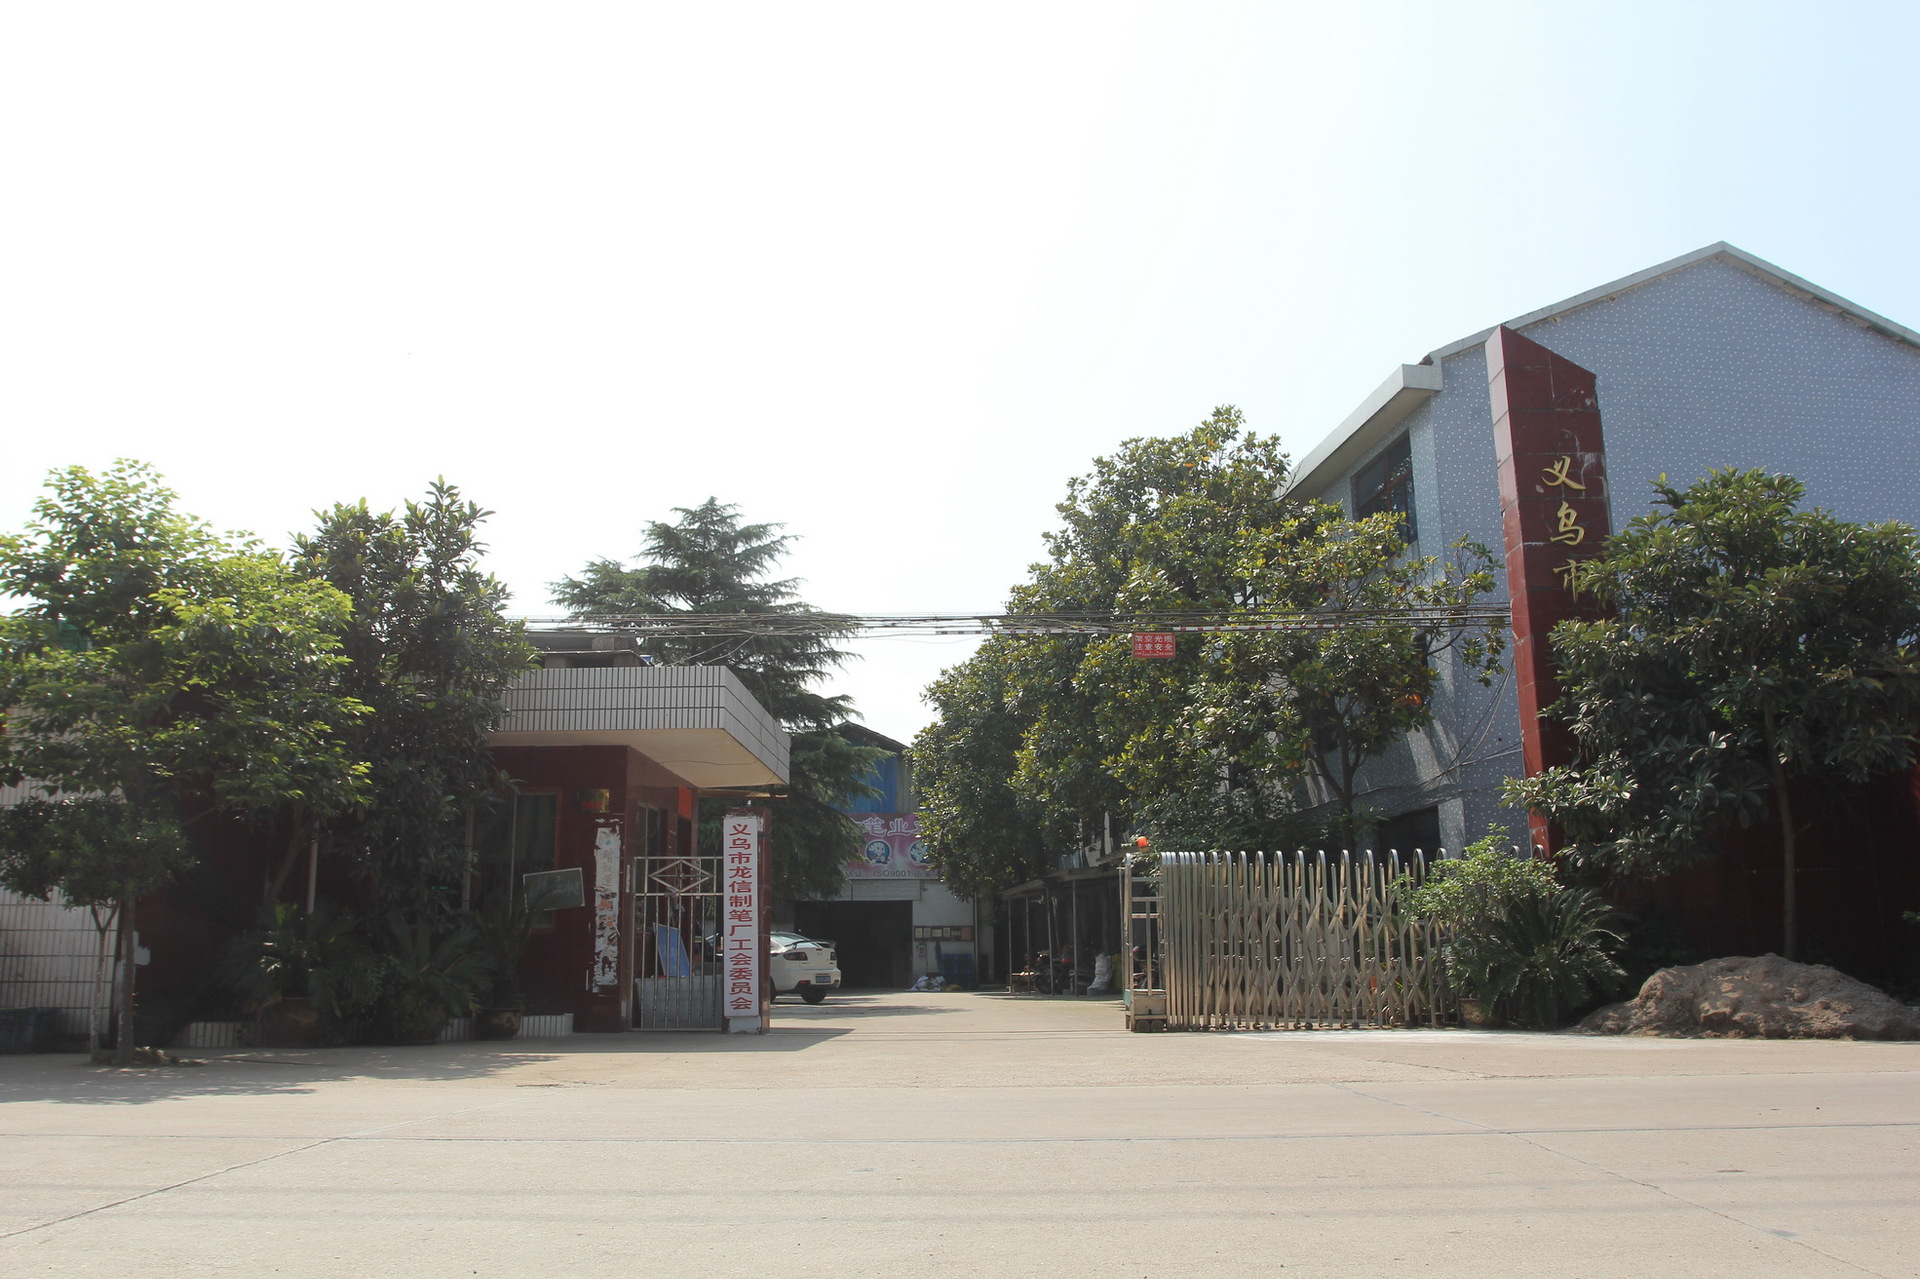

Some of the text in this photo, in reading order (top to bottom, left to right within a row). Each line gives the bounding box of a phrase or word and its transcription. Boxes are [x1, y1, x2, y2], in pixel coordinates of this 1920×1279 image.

[1135, 643, 1173, 651] 注意安全
[729, 823, 753, 1010] 义乌市龙信制笔厂工会委员会
